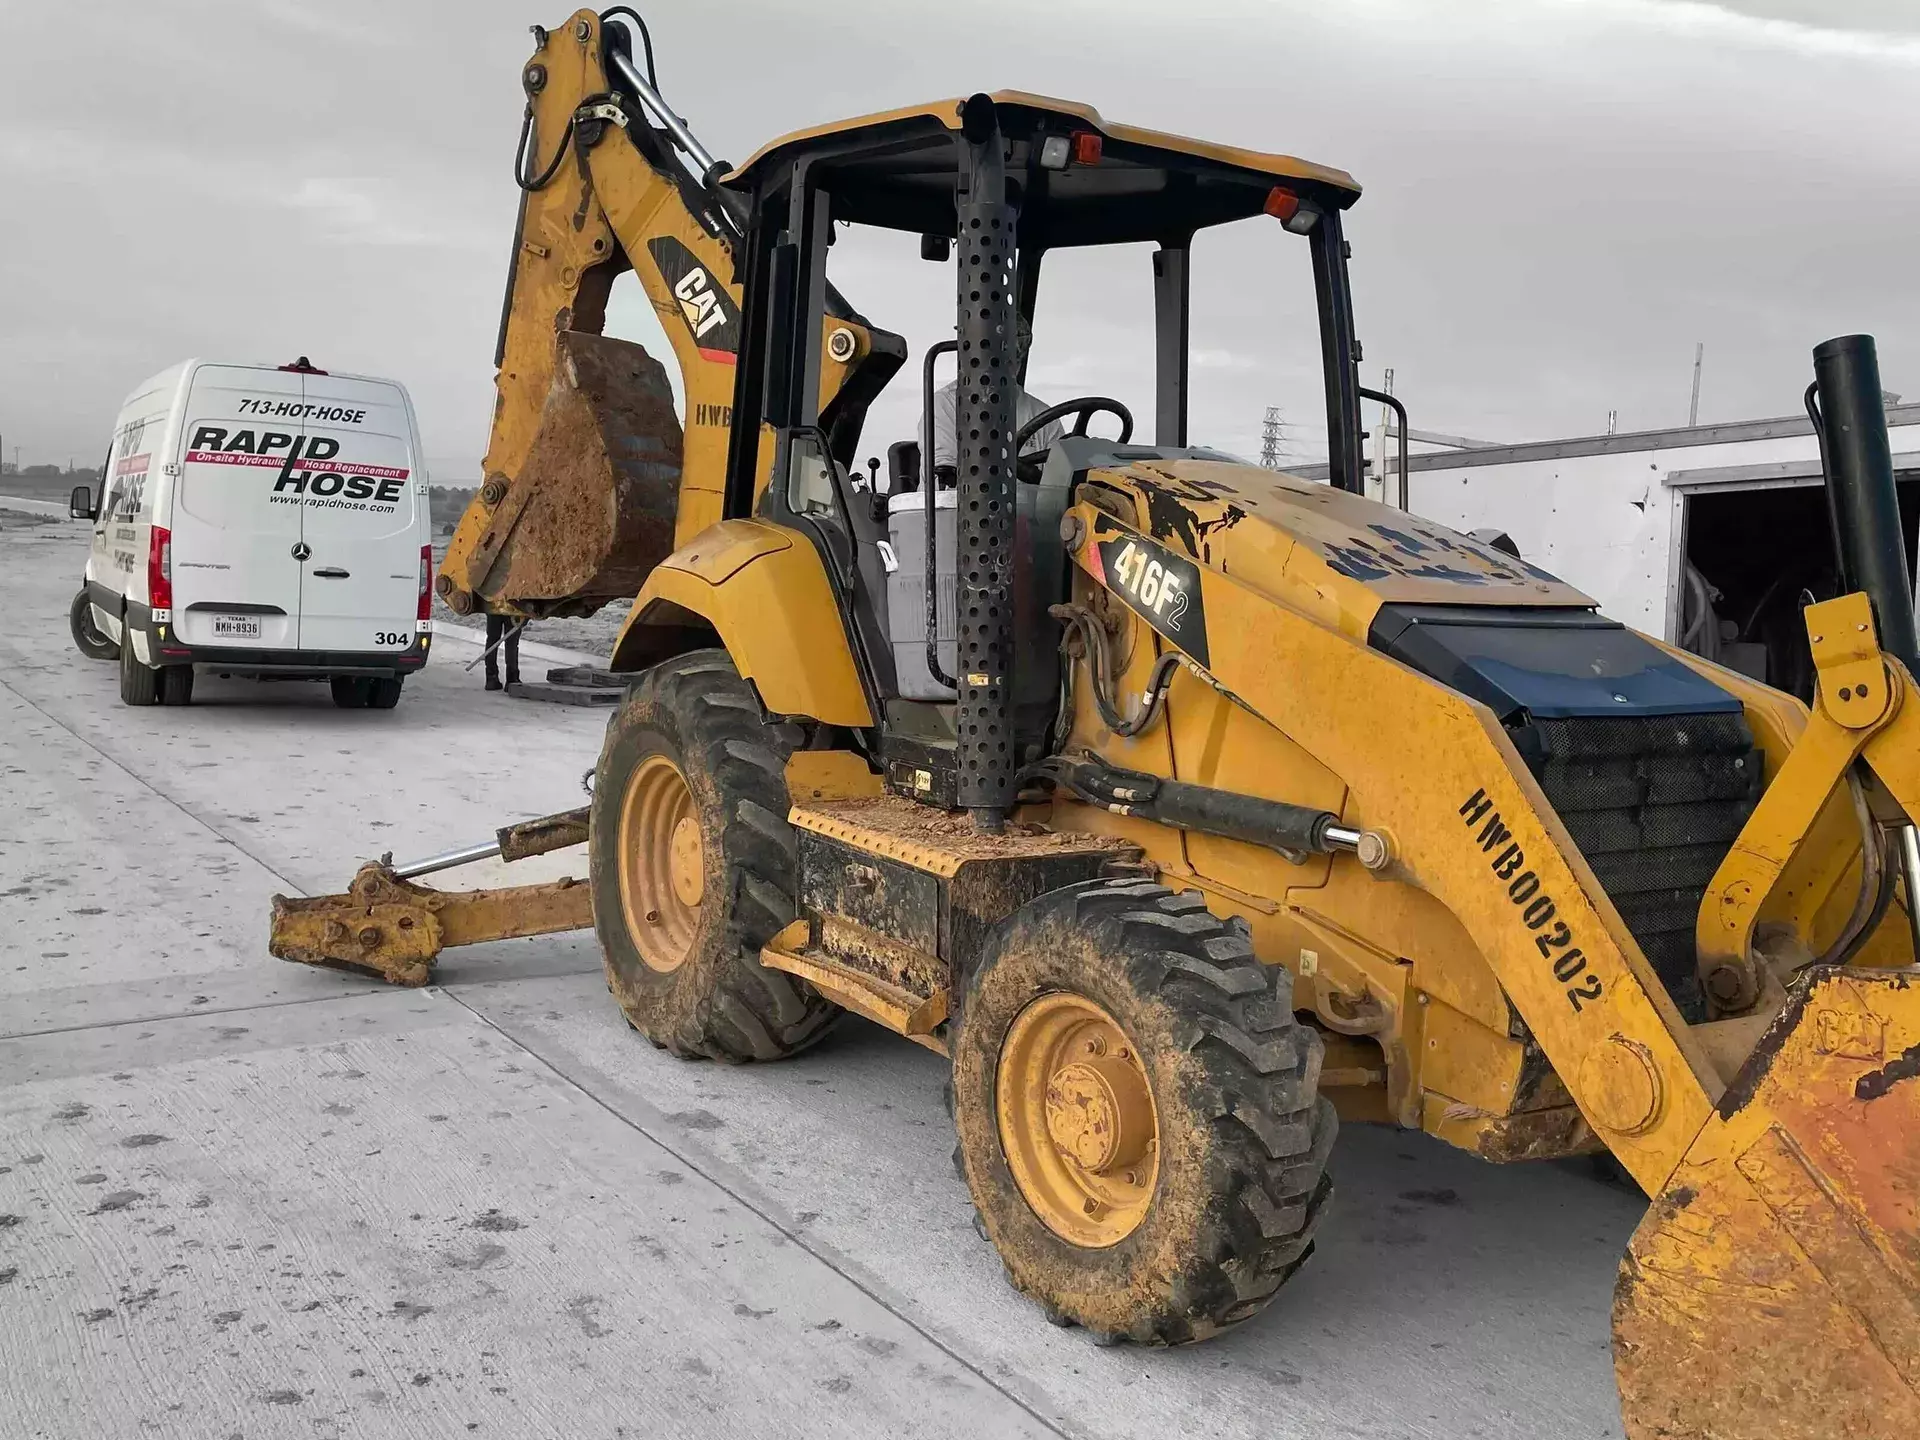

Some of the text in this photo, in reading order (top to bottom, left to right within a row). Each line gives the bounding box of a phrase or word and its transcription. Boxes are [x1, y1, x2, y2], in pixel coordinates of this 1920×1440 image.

[674, 267, 728, 339] CAT
[238, 399, 366, 424] 713-HOT-HOSE
[190, 426, 340, 461] RAPID
[196, 452, 401, 479] On-site Hydraulic Hose Replacement
[273, 470, 405, 503] HOSE
[269, 495, 395, 514] www.rapidhose.com
[374, 632, 409, 646] 304
[1459, 787, 1602, 1013] HWB00202
